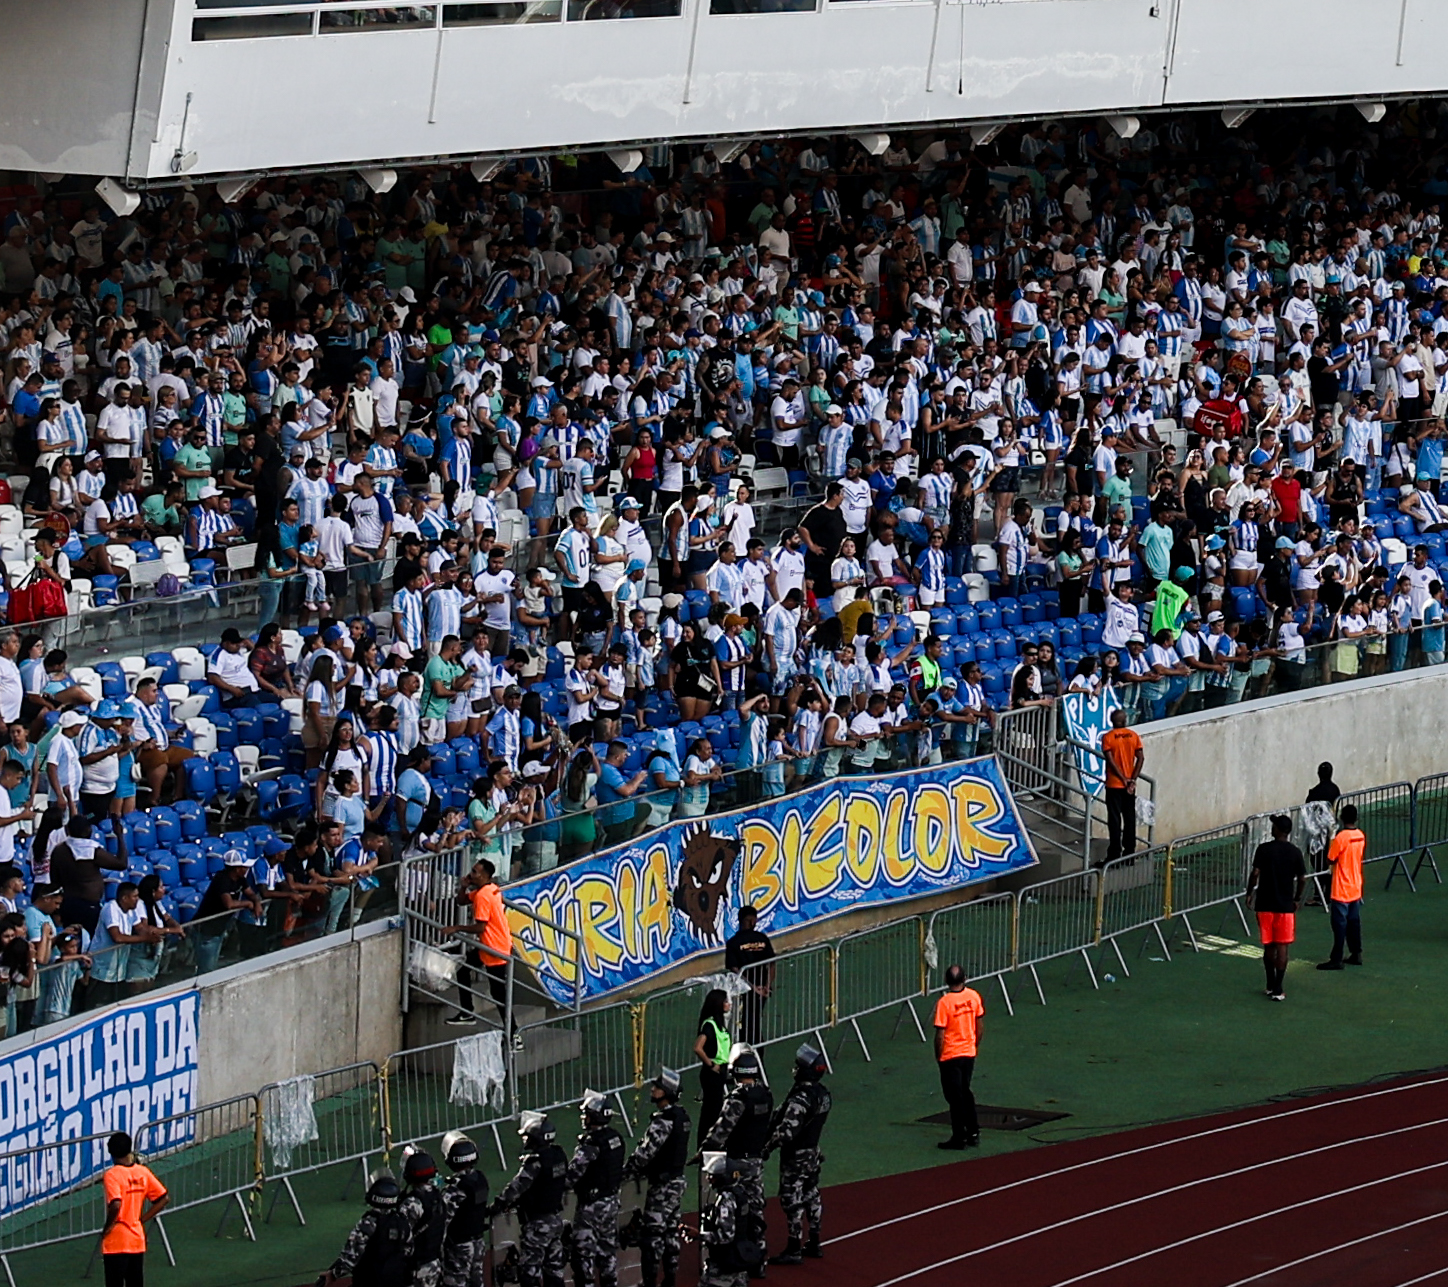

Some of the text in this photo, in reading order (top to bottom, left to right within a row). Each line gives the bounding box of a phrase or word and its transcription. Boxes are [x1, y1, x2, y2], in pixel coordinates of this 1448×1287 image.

[740, 780, 1015, 912] BICOLOR
[155, 996, 198, 1076] DA
[91, 1069, 199, 1168] NORTE!
